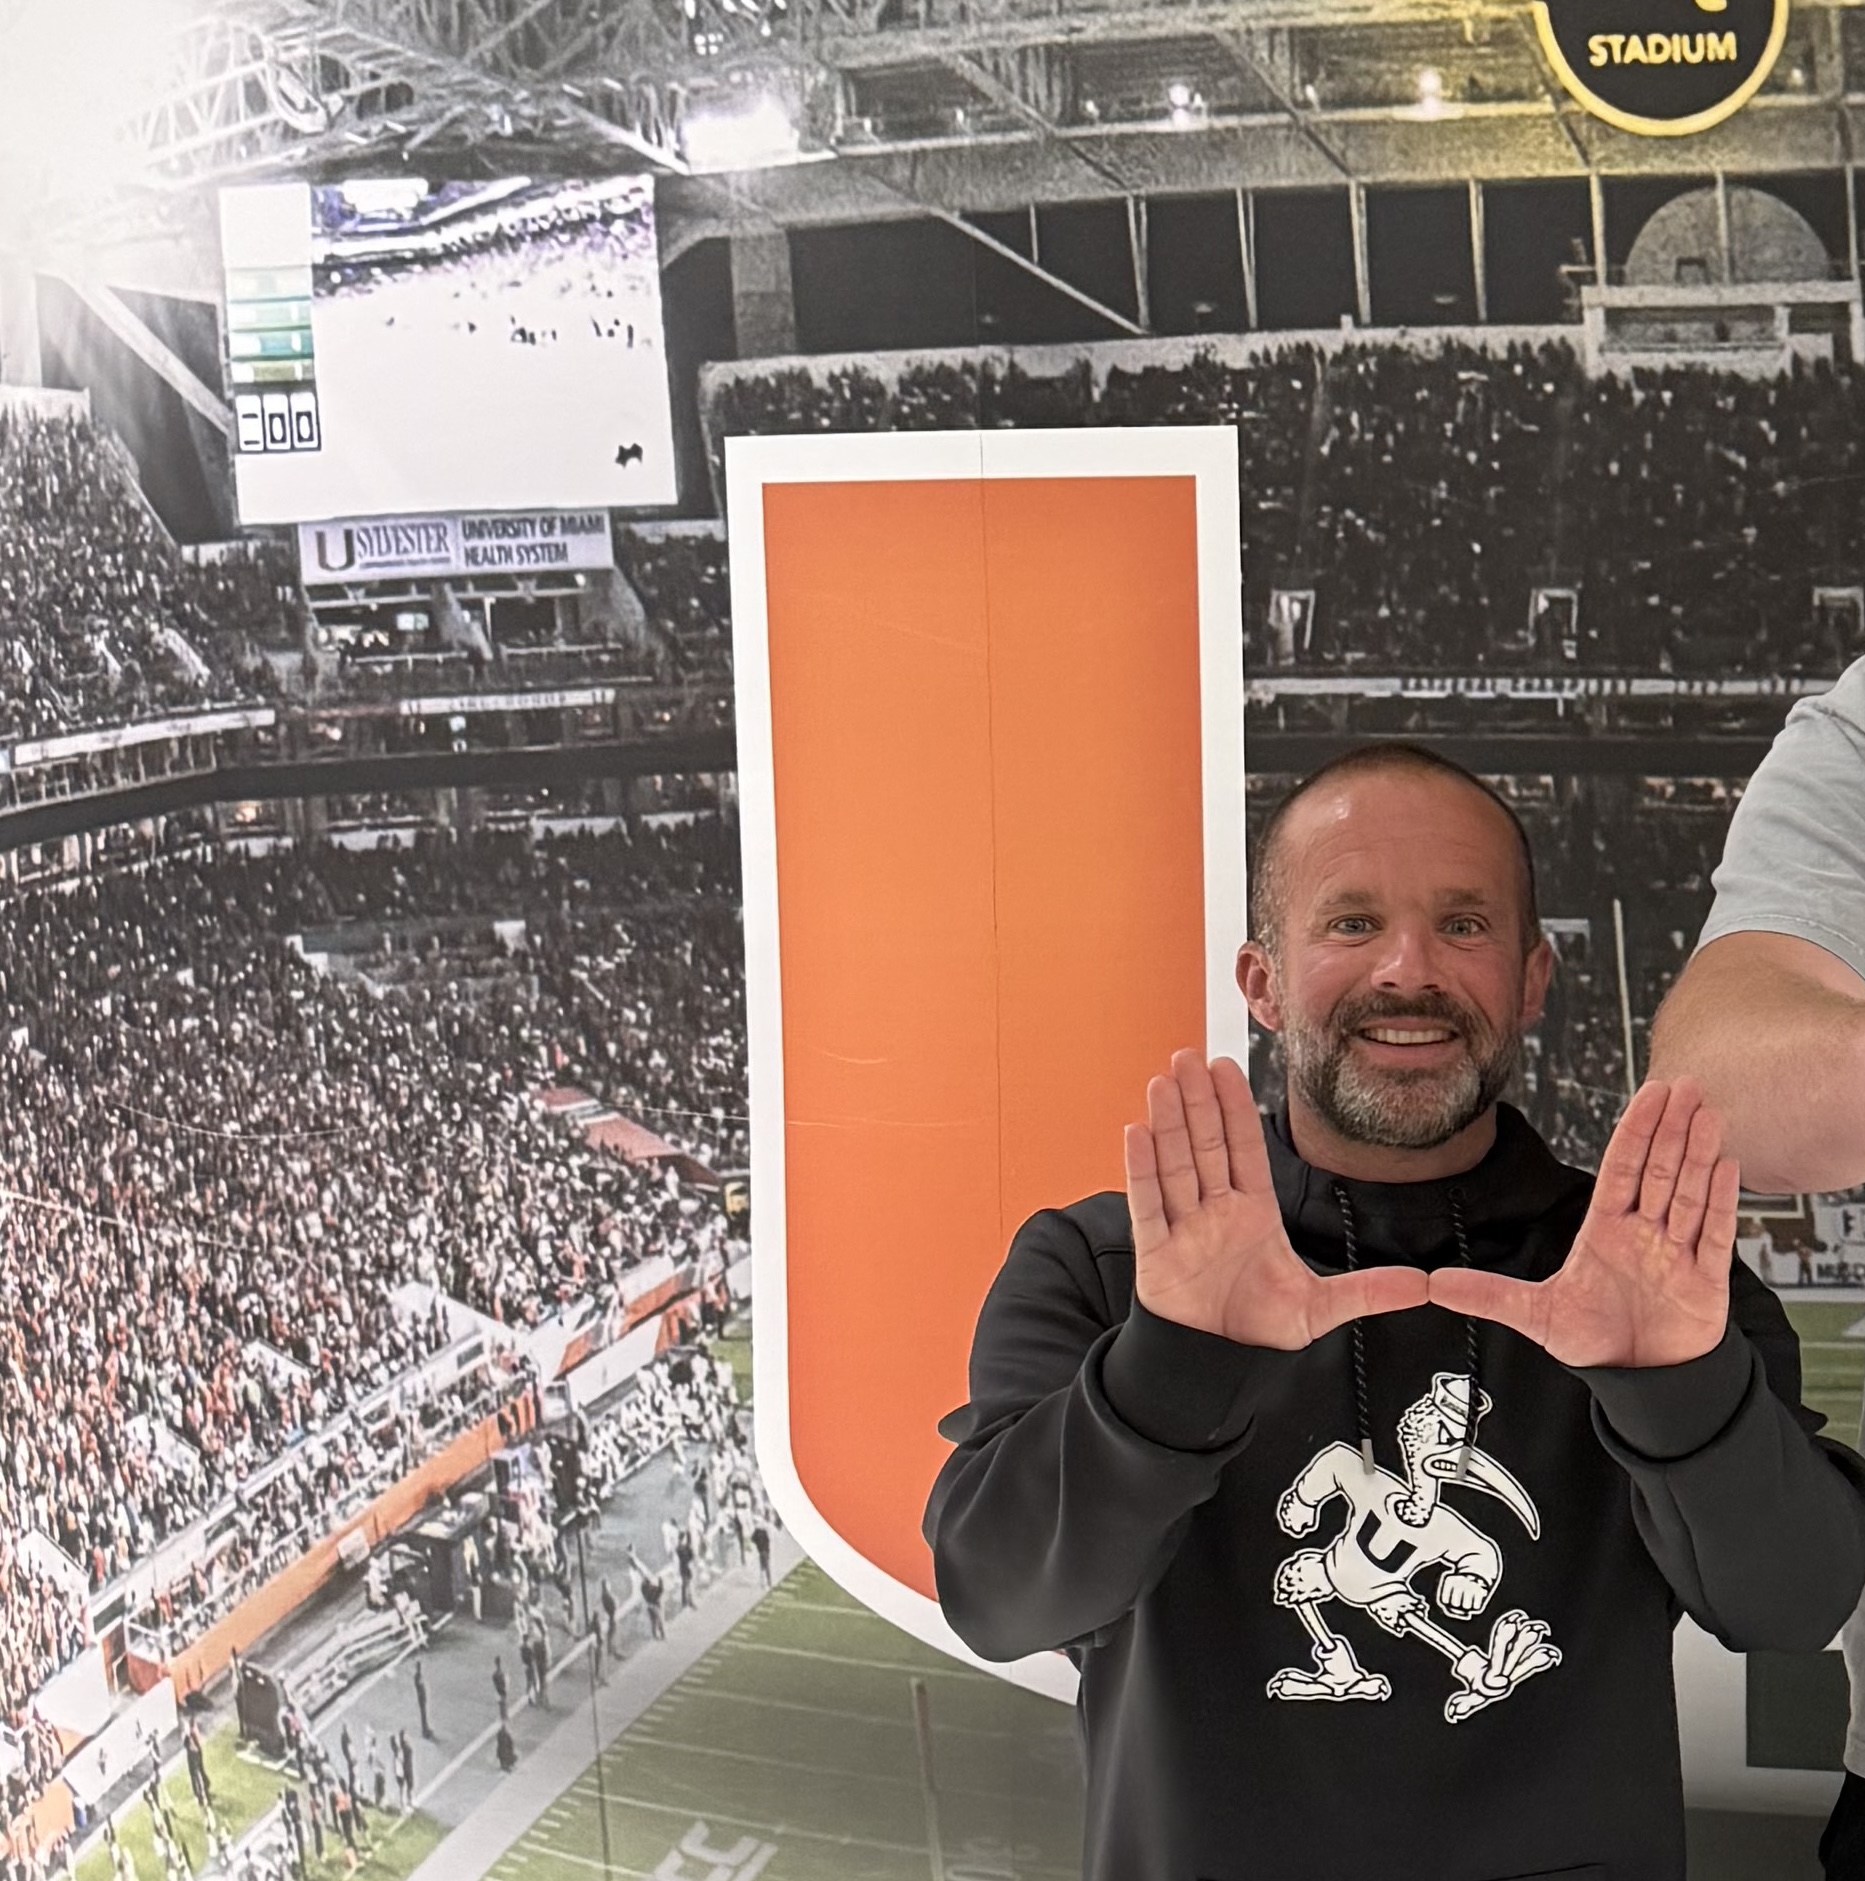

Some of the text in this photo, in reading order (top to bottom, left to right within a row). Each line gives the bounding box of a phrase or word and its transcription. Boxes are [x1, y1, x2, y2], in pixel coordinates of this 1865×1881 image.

[1587, 31, 1737, 67] STADIUM
[356, 521, 450, 559] SYLVESTER
[462, 517, 537, 541] UNIVERSITY
[539, 515, 558, 538] OF
[464, 544, 514, 567] HEALTH
[515, 541, 569, 566] SYSTEM
[1355, 1508, 1419, 1574] U
